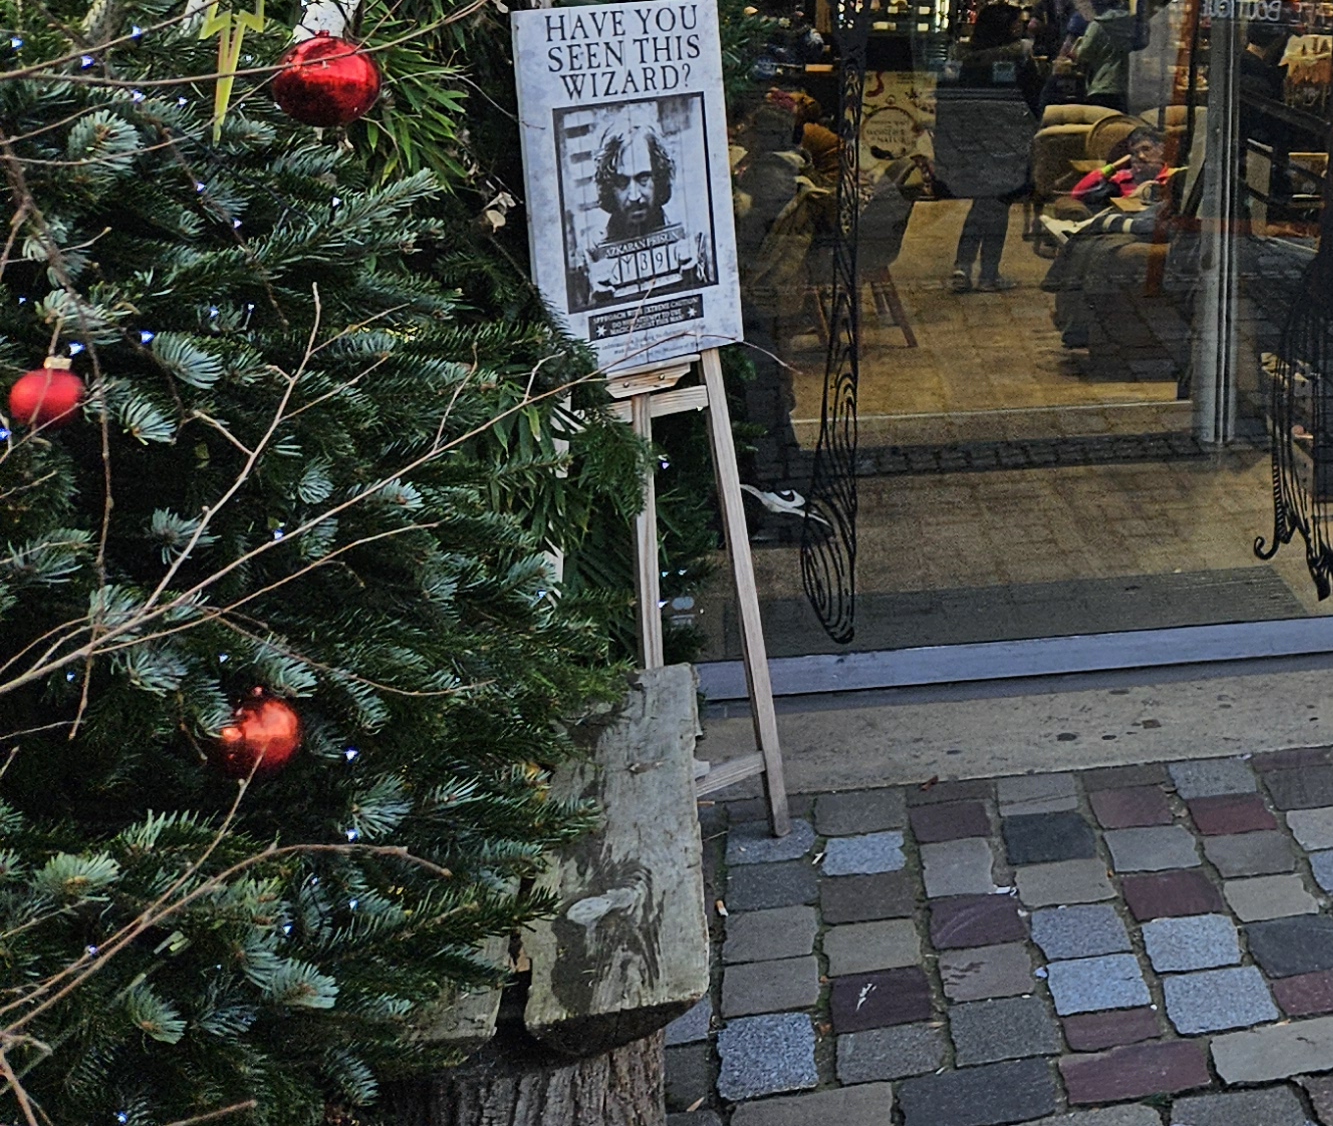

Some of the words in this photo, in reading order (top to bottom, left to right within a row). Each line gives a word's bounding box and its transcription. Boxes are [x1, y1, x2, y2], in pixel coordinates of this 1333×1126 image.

[545, 11, 626, 42] HAVE
[634, 4, 698, 35] YOU
[548, 40, 624, 73] SEEN
[633, 34, 701, 64] THIS
[560, 63, 691, 101] WIZARD?
